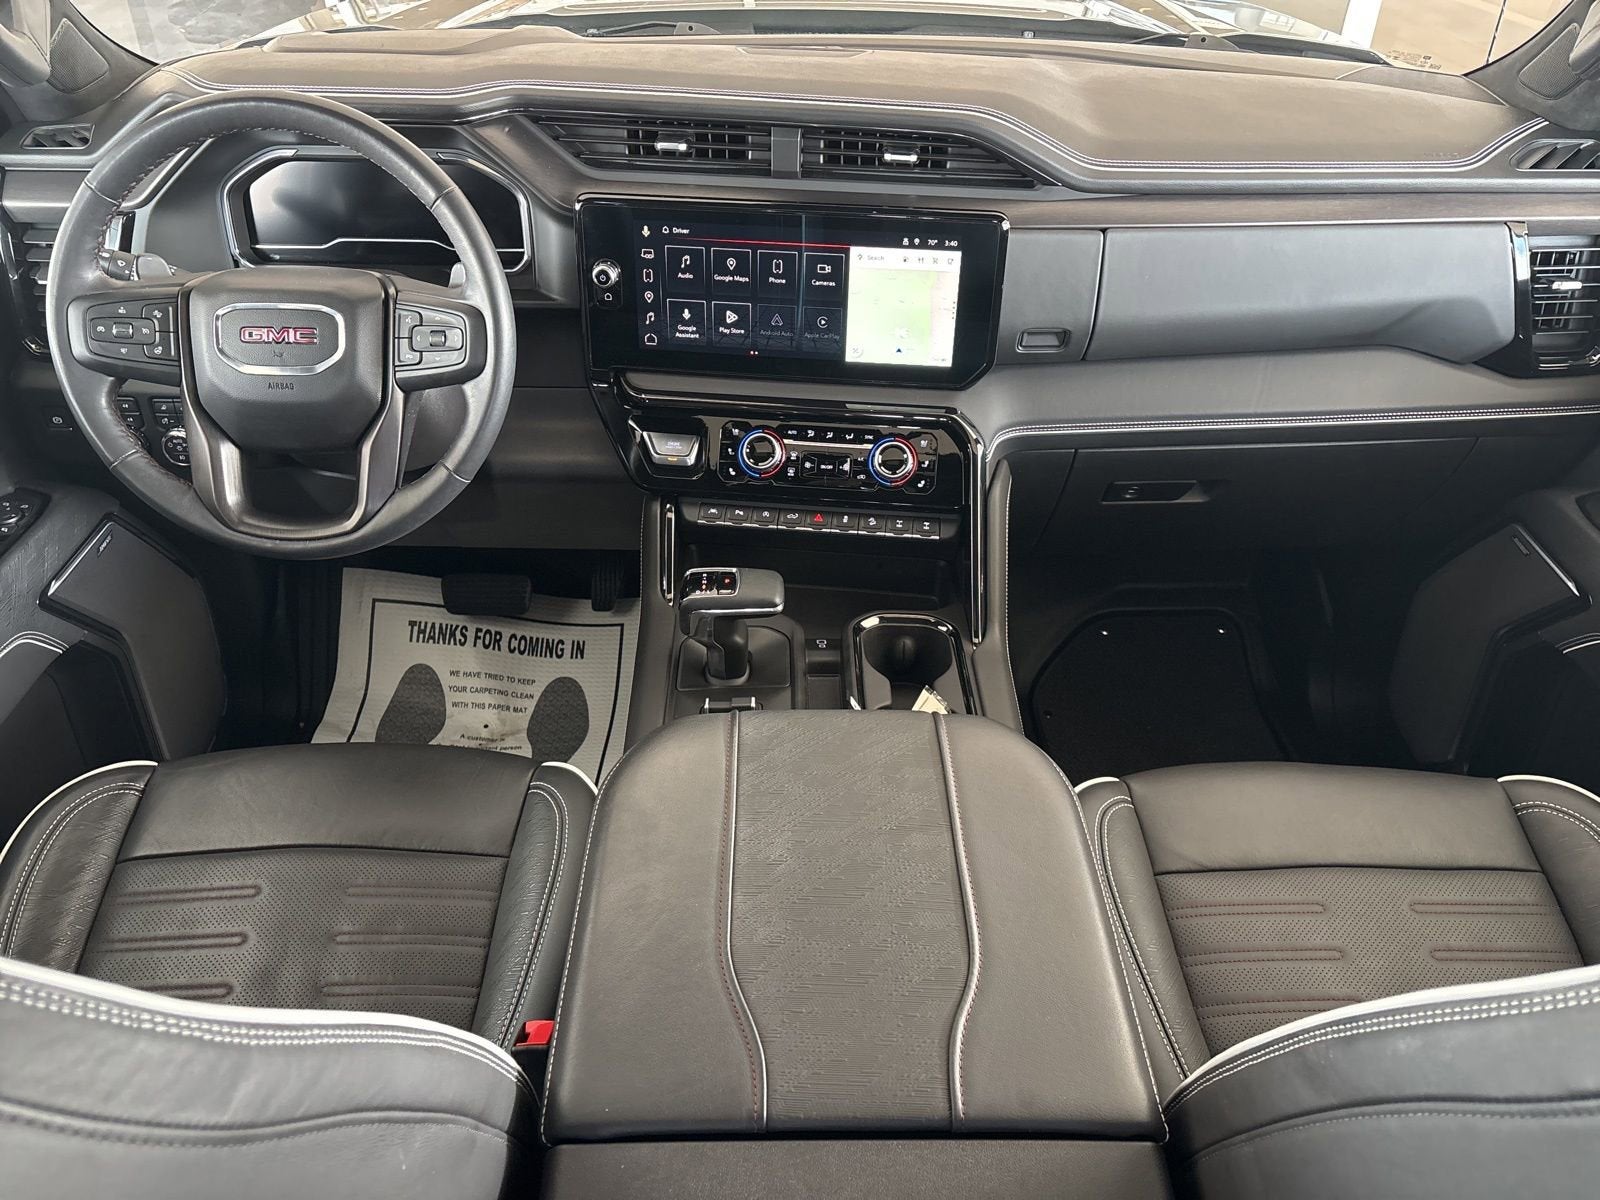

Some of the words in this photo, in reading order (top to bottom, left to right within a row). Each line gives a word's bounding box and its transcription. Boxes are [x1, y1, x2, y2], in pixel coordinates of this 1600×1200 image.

[672, 227, 690, 235] Driver
[713, 274, 733, 282] Google
[768, 276, 786, 284] Phone
[677, 324, 697, 332] Google
[719, 326, 730, 334] Play
[240, 326, 319, 345] GMC
[675, 331, 700, 339] Assistant
[267, 382, 295, 391] AIRBAG
[408, 620, 469, 647] THANKS
[473, 627, 503, 652] FOR
[507, 633, 565, 659] COMING
[570, 639, 586, 660] IN
[449, 669, 461, 678] WE
[462, 671, 482, 679] HAVE
[483, 672, 504, 681] TRIED
[506, 675, 516, 684] TO
[517, 678, 536, 686] KEEP
[448, 685, 467, 693] YOUR
[469, 686, 509, 697] CARPETING
[510, 691, 535, 700] CLEAN
[451, 701, 469, 709] WITH
[470, 702, 486, 710] THIS
[487, 703, 511, 713] PAPER
[512, 706, 528, 714] MAT
